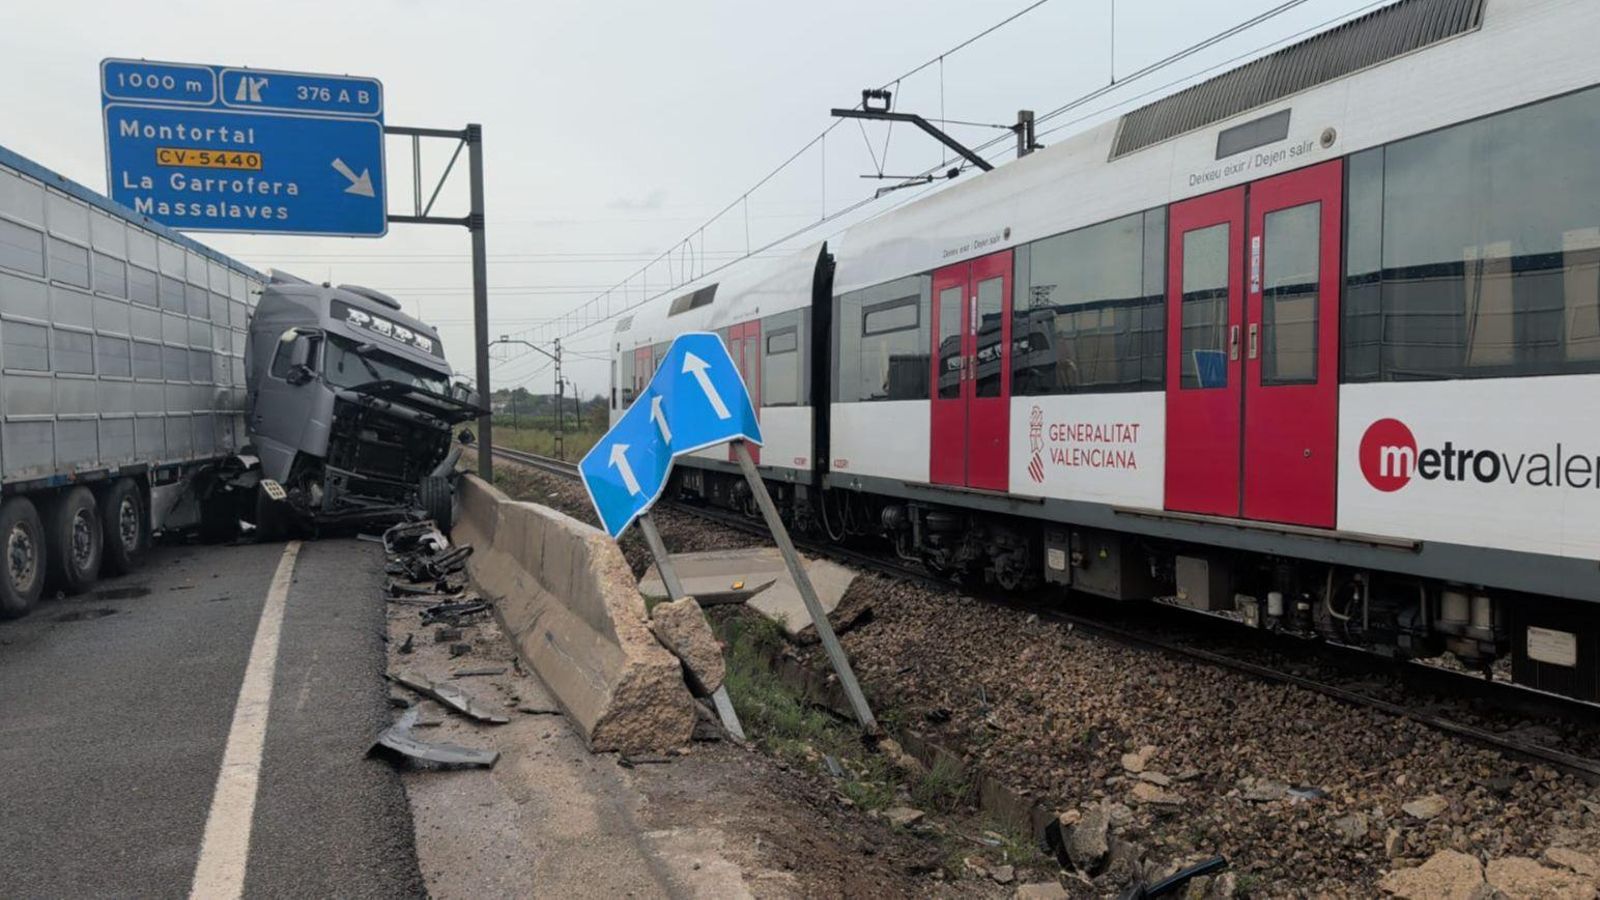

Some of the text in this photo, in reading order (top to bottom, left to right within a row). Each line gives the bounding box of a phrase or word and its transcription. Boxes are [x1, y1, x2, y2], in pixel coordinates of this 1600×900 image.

[118, 73, 202, 92] 1000 m
[297, 86, 370, 104] 376 A B
[119, 119, 254, 144] Montortal
[159, 150, 258, 167] CV-5440
[1189, 168, 1222, 186] Deixeu
[1255, 150, 1286, 167] Dejen
[1290, 140, 1314, 157] salir
[123, 171, 298, 196] La Garrofera
[135, 197, 288, 219] Massalaves
[1049, 423, 1140, 443] GENERALITAT
[1049, 447, 1137, 470] VALENCIANA
[1379, 441, 1600, 489] metrovale
